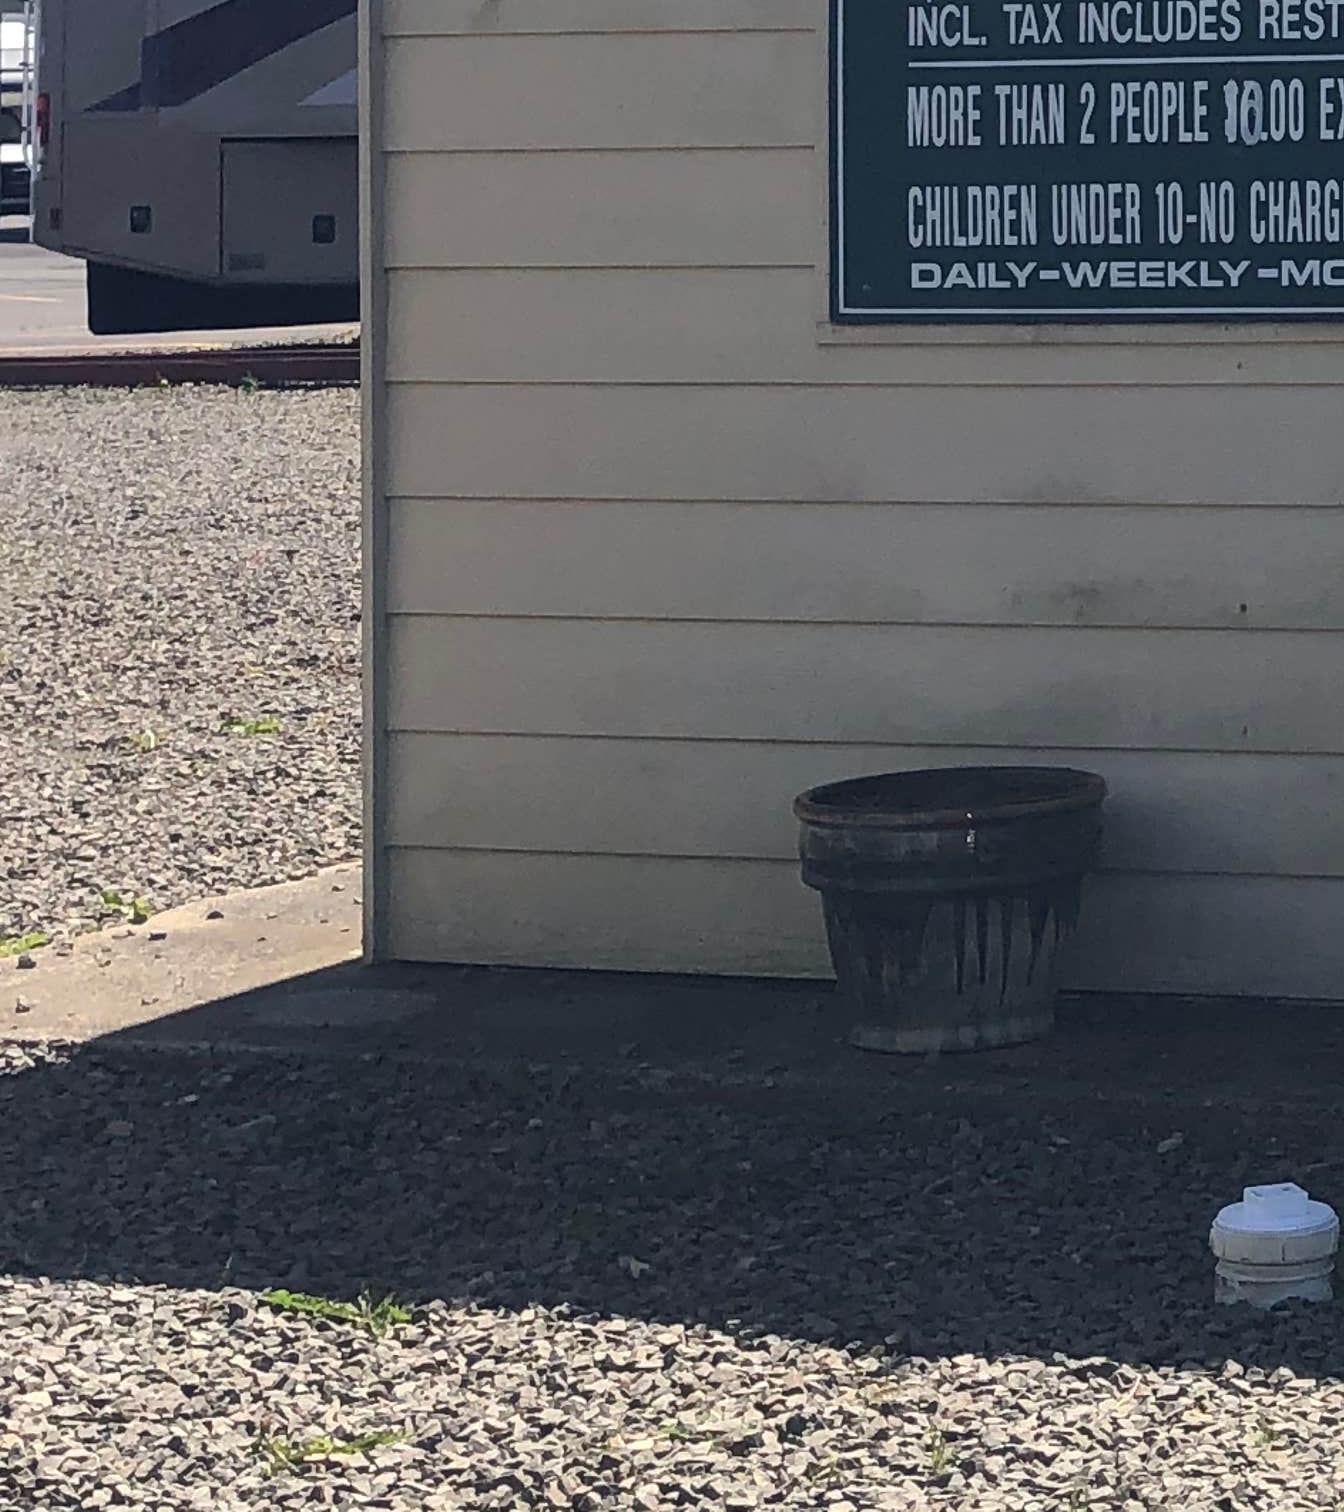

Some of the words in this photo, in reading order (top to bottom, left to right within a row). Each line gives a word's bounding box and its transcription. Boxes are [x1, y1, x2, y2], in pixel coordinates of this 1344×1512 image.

[909, 5, 986, 46] INCL.
[1003, 3, 1062, 44] TAX
[908, 86, 981, 147] MORE
[995, 84, 1064, 145] THAN
[1080, 83, 1094, 144] 2
[1111, 81, 1208, 142] PEOPLE
[909, 185, 1036, 247] CHILDREN
[1052, 184, 1140, 245] UNDER
